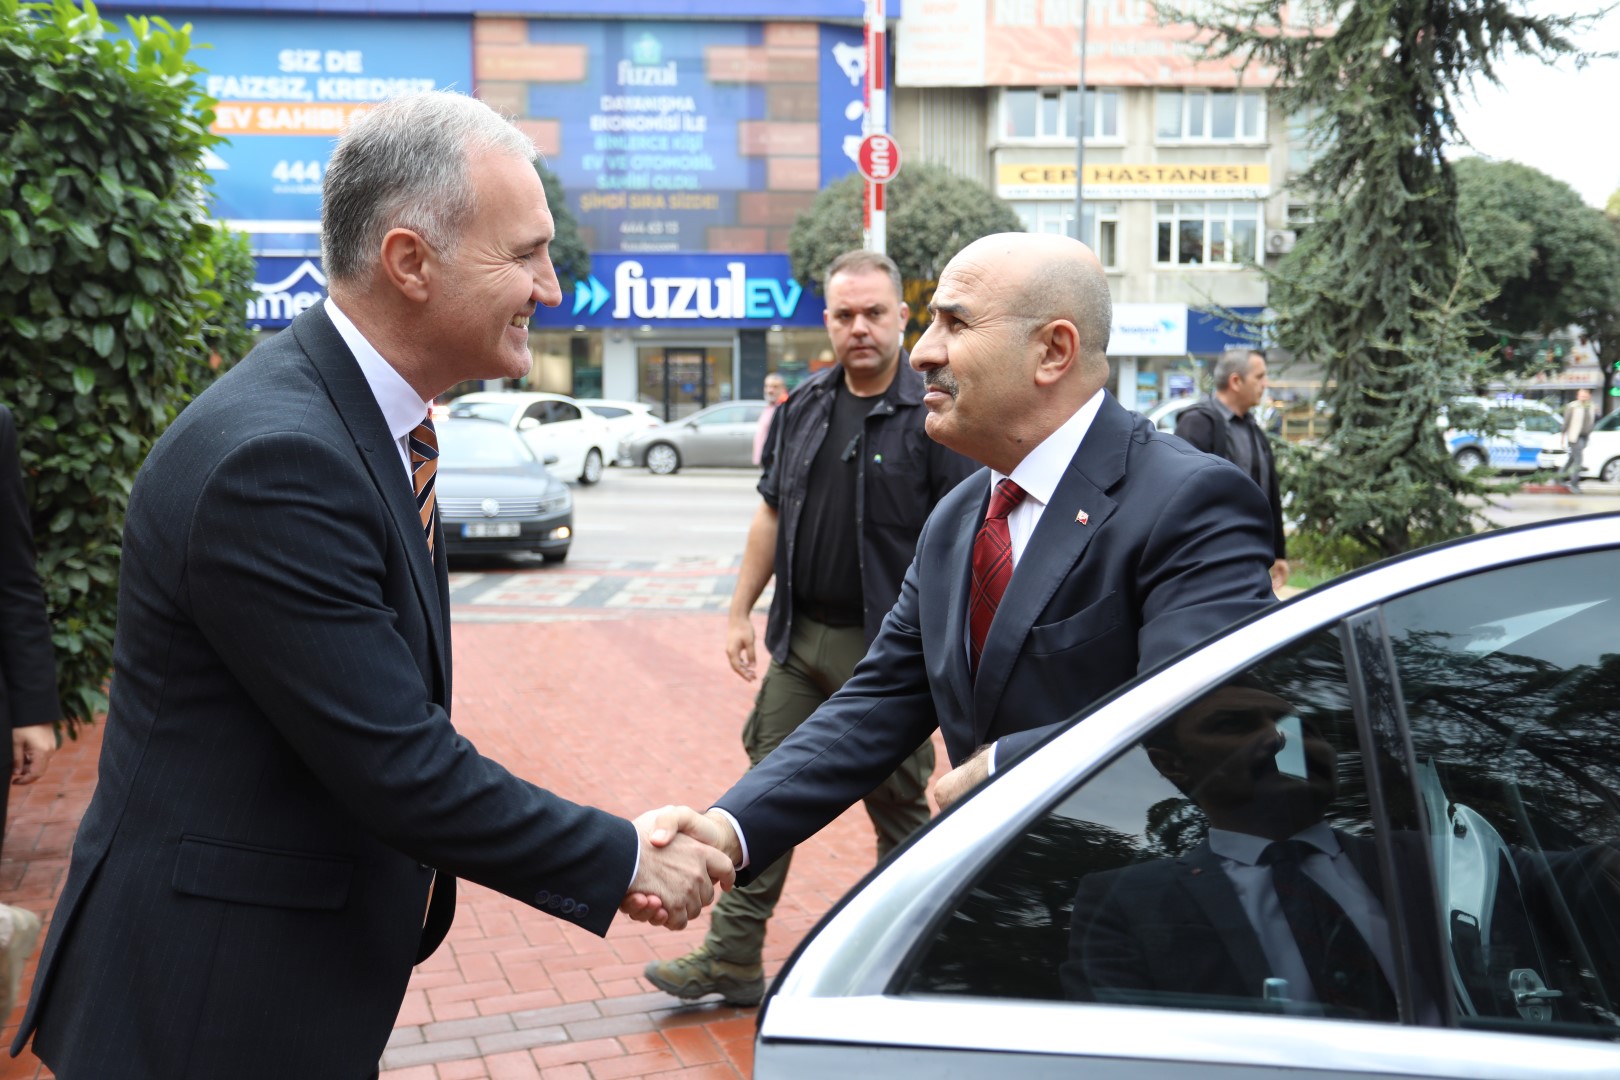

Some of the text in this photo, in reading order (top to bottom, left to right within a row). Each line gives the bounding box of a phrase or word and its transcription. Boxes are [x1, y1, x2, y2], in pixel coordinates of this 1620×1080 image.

[278, 48, 363, 74] SİZ DE
[617, 60, 678, 86] fuzul
[207, 75, 314, 103] FAİZSİZ,
[217, 107, 253, 129] EV
[870, 138, 890, 178] DUR
[272, 160, 321, 183] 444
[1094, 165, 1250, 184] HASTANESİ
